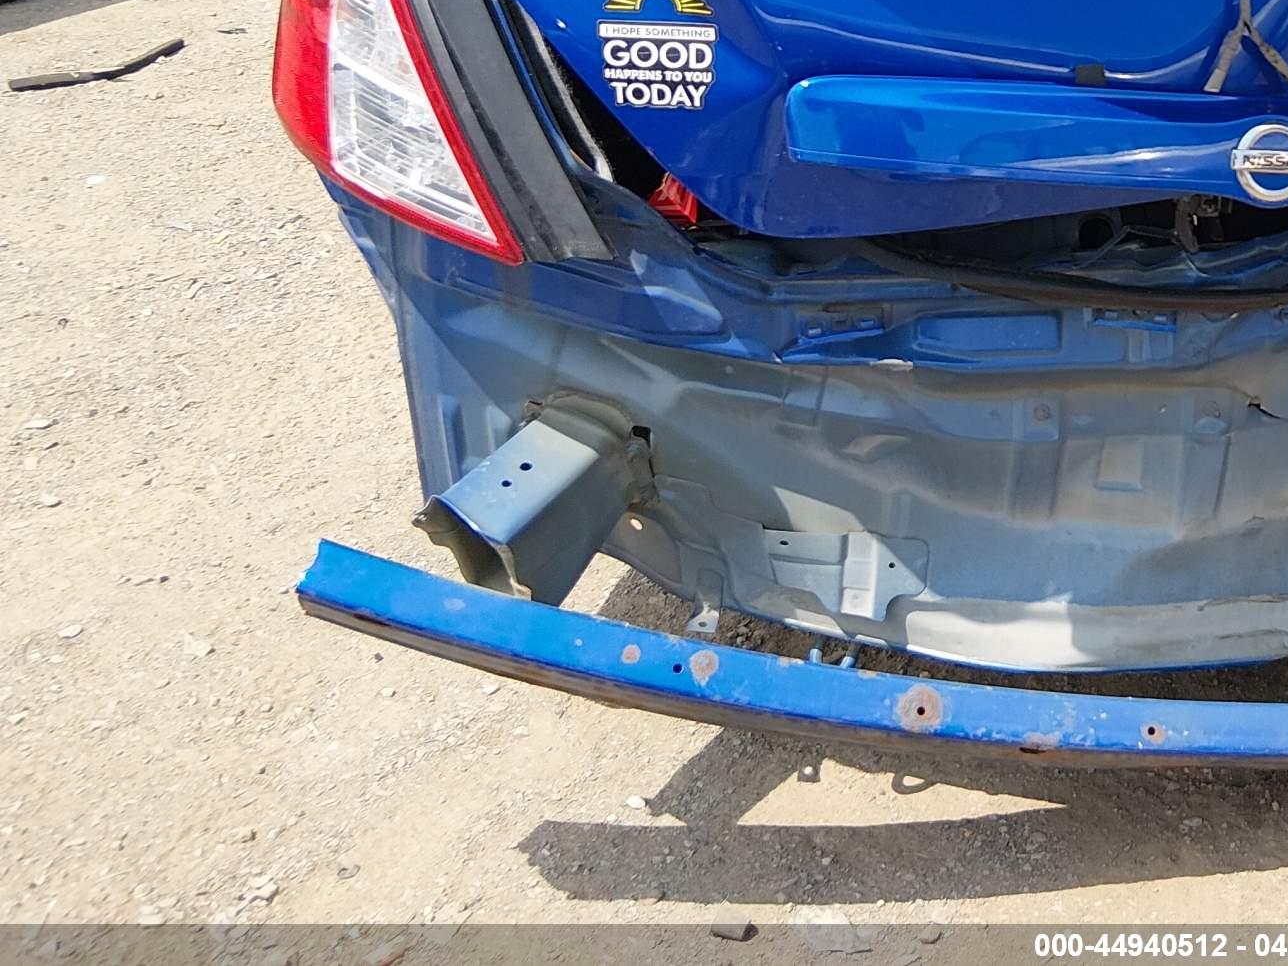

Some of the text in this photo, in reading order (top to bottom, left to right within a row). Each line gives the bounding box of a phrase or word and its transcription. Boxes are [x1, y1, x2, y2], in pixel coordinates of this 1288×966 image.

[611, 26, 642, 35] HOPE
[645, 28, 712, 38] SOMETHING
[603, 40, 713, 69] GOOD
[604, 68, 712, 82] HAPPENS TO YOU
[610, 82, 707, 107] TODAY
